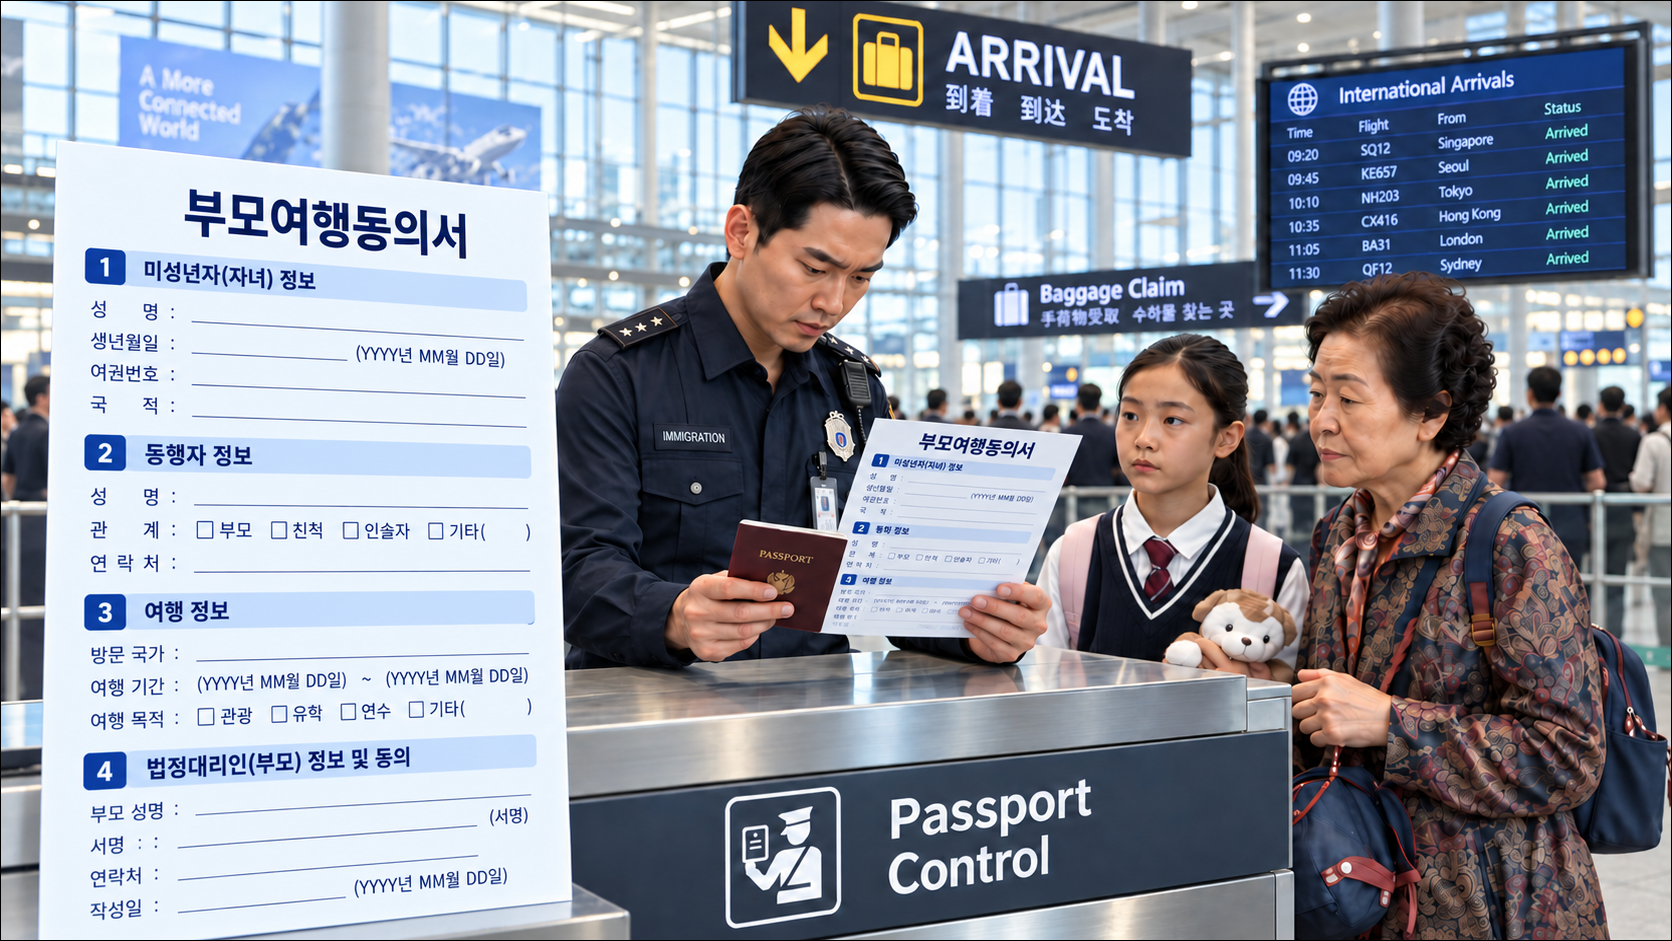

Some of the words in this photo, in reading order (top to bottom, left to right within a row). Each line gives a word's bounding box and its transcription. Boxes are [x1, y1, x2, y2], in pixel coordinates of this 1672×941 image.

[138, 65, 156, 89] A
[163, 68, 214, 96] More
[945, 32, 1135, 99] ARRIVAL
[946, 84, 993, 117] 到着
[1340, 76, 1445, 104] International
[1451, 70, 1514, 92] Arrivals
[138, 90, 241, 125] Connected
[1021, 96, 1066, 126] 到达
[1093, 107, 1134, 136] 도착
[1287, 127, 1313, 138] Time
[1359, 118, 1389, 134] Flight
[1438, 113, 1466, 124] From
[1545, 103, 1581, 115] Status
[138, 113, 199, 141] World
[1288, 149, 1318, 162] 09:20
[1361, 142, 1390, 156] SQ12
[1438, 136, 1493, 151] Singapore
[1545, 123, 1588, 139] Arrived
[1288, 172, 1319, 185] 09:45
[1362, 165, 1397, 179] KE657
[1439, 159, 1469, 173] Seoul
[1546, 148, 1588, 164] Arrived
[1289, 196, 1319, 209] 10:10
[1362, 190, 1399, 204] NH203
[1439, 185, 1473, 200] Tokyo
[1546, 174, 1588, 189] Arrived
[185, 189, 466, 259] 부모여행동의서
[1289, 220, 1319, 233] 10:35
[1362, 214, 1398, 227] CX416
[1439, 211, 1469, 224] Hong
[1472, 208, 1501, 221] Kong
[1546, 200, 1588, 214] Arrived
[1289, 243, 1319, 256] 11:05
[1363, 239, 1390, 251] BA31
[1440, 233, 1483, 246] London
[1546, 225, 1589, 240] Arrived
[100, 258, 109, 277] 1
[145, 261, 272, 290] 미성년자(자녀)
[280, 270, 316, 290] 정보
[1289, 267, 1320, 279] 11:30
[1362, 263, 1392, 277] QF12
[1441, 258, 1482, 274] Sydney
[1546, 251, 1589, 265] Arrived
[1041, 284, 1123, 307] Baggage
[1128, 276, 1184, 298] Claim
[91, 301, 106, 318] 성
[144, 303, 157, 321] 명
[1041, 308, 1119, 327] 手荷物受取
[1133, 304, 1176, 323] 수하물
[1183, 302, 1213, 321] 찾는
[1219, 301, 1234, 318] 곳
[91, 332, 158, 352] 생년월일
[357, 345, 412, 363] (YYYY년
[420, 349, 458, 365] MM월
[466, 352, 504, 368] DD일)
[91, 364, 158, 382] 여권번호
[91, 396, 107, 413] 국
[143, 397, 157, 415] 적
[663, 431, 725, 443] IMMIGRATION
[919, 433, 1035, 459] 부모여행동의서
[98, 443, 112, 463] 2
[145, 444, 206, 466] 동행자
[213, 445, 252, 466] 정보
[91, 488, 106, 505] 성
[144, 488, 158, 506] 명
[91, 521, 107, 539] 관
[144, 521, 158, 539] 계
[220, 522, 252, 539] 부모
[293, 522, 322, 539] 친척
[365, 523, 410, 539] 인솔자
[91, 555, 106, 572] 연
[118, 554, 133, 572] 락
[144, 555, 158, 572] 처
[759, 550, 813, 564] PASSPORT
[98, 602, 112, 622] 3
[145, 601, 182, 623] 여행
[191, 601, 229, 622] 정보
[92, 646, 125, 664] 방문
[132, 645, 164, 663] 국가
[91, 679, 123, 697] 여행
[132, 678, 164, 696] 기간
[198, 674, 253, 693] (YYYY년
[261, 673, 299, 689] MM월
[307, 672, 346, 689] DD일)
[386, 669, 439, 688] (YYYY년
[446, 668, 483, 684] MM월
[490, 667, 528, 684] DD일)
[91, 712, 123, 730] 여행
[132, 711, 163, 729] 목적
[221, 707, 252, 725] 관광
[293, 705, 322, 722] 유학
[362, 703, 391, 720] 연수
[97, 761, 113, 781] 4
[148, 751, 301, 780] 법정대리인(부모)
[308, 750, 345, 771] 정보
[352, 748, 368, 769] 및
[375, 746, 409, 768] 동의
[91, 806, 124, 823] 부모
[132, 802, 162, 821] 성명
[891, 779, 1092, 839] Passport
[91, 836, 123, 855] 서명
[490, 807, 528, 826] (서명)
[91, 867, 141, 888] 연락처
[888, 834, 1049, 895] Control
[91, 899, 141, 920] 작성일
[355, 875, 412, 898] (YYYY년
[420, 871, 459, 889] MM월
[467, 868, 507, 885] DD일)
